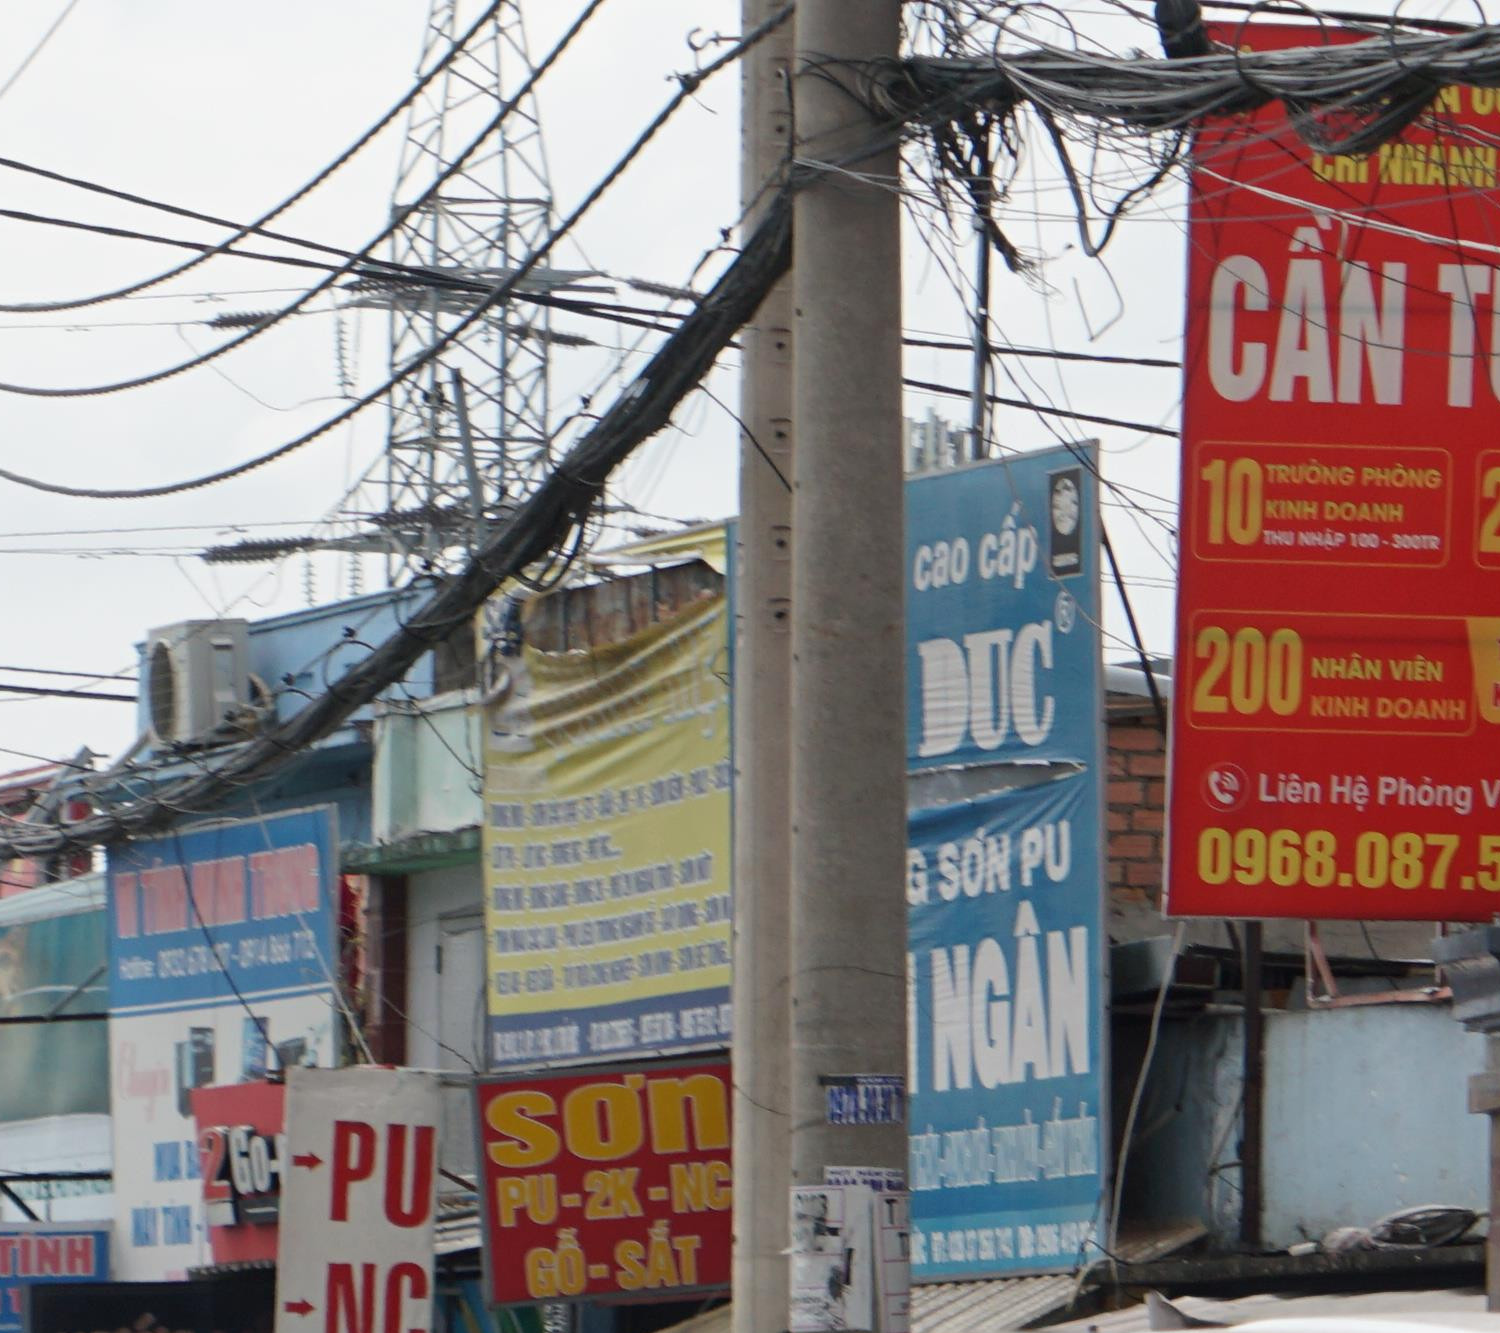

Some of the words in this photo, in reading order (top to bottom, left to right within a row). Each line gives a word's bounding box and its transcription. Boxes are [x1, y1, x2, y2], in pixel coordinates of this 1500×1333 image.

[1207, 208, 1407, 405] CẦN
[1200, 457, 1263, 546] 10
[1264, 498, 1318, 521] KINH
[1324, 501, 1404, 523] DOANH
[1265, 461, 1355, 489] TRƯỞNG
[1362, 462, 1443, 491] PHÒNG
[912, 537, 971, 592] cao
[979, 500, 1038, 590] cấp
[1263, 529, 1295, 546] THU
[1192, 624, 1304, 717] 200
[1308, 694, 1369, 720] KINH
[1373, 696, 1467, 722] DOANH
[1309, 651, 1382, 681] NHÂN
[1389, 653, 1444, 684] VIÊN
[1258, 773, 1322, 804] Liên
[1330, 774, 1370, 813] Hệ
[1378, 775, 1475, 816] Phỏng
[938, 827, 1012, 902] SƠN
[1021, 819, 1071, 888] PU
[930, 900, 1091, 1092] NGÂN
[330, 1119, 435, 1229] PU
[495, 1173, 559, 1228] PU
[669, 1160, 732, 1214] NC
[524, 1227, 587, 1299] GỖ
[613, 1218, 702, 1291] SẮT
